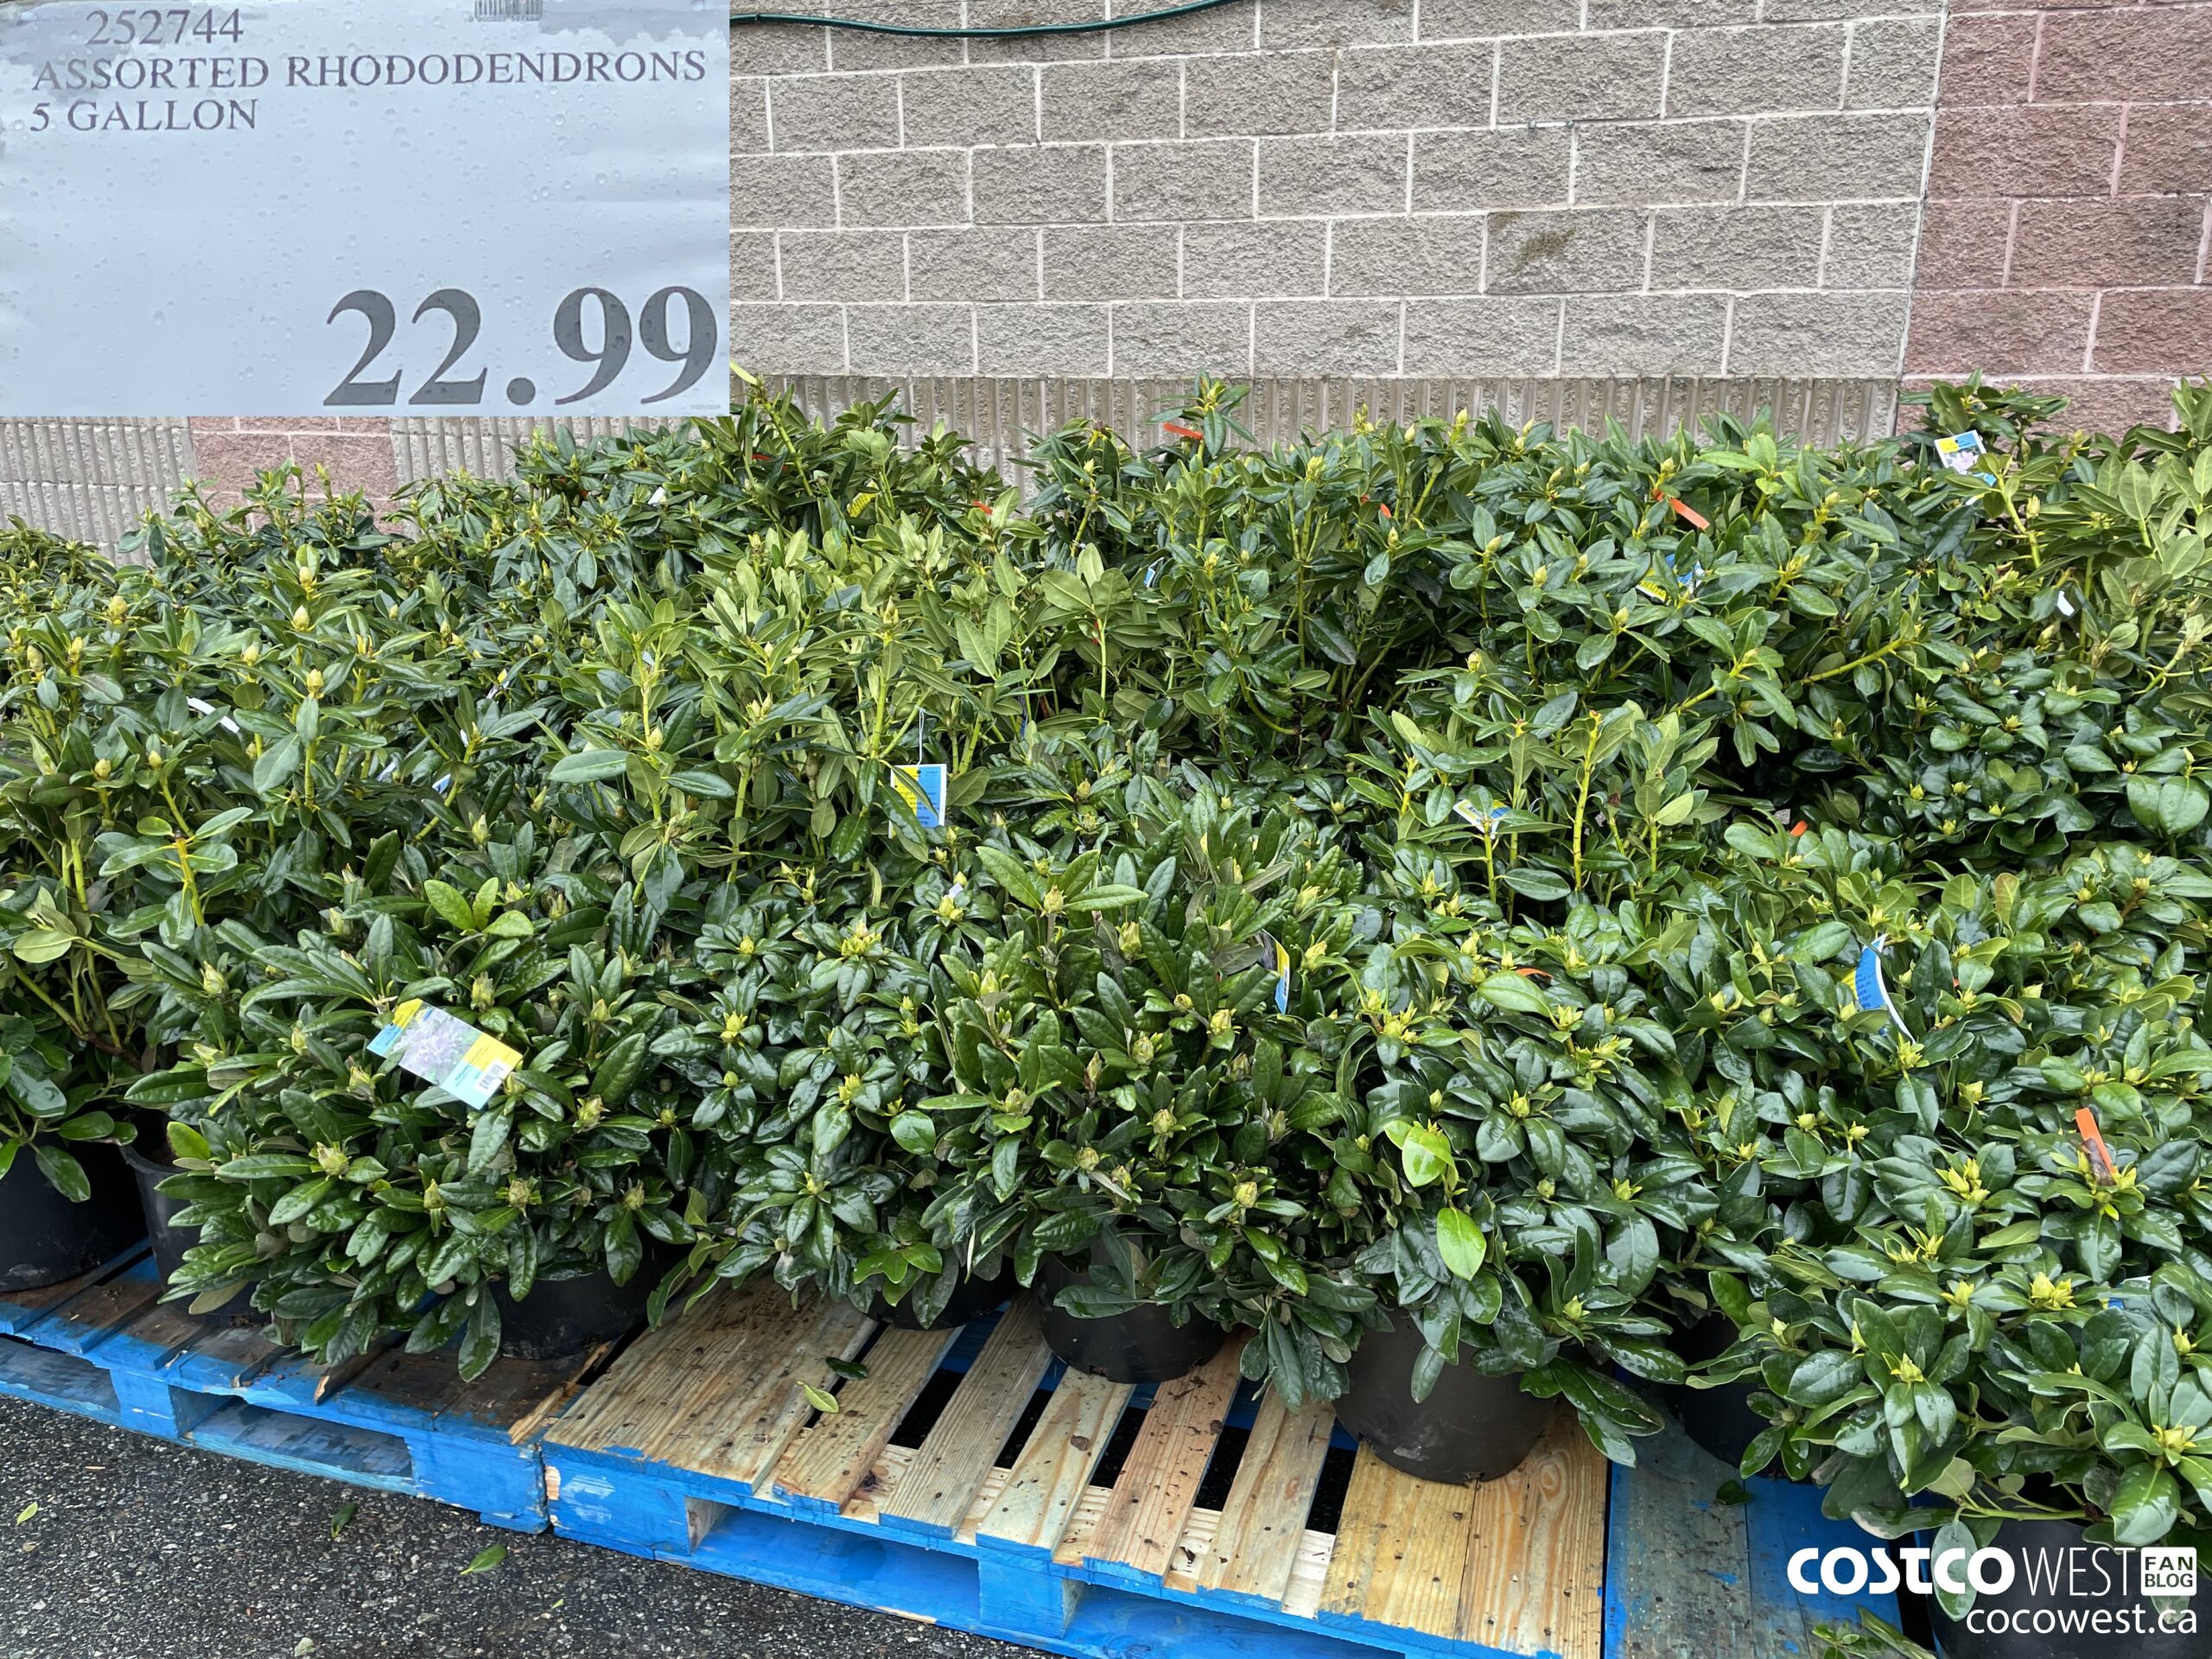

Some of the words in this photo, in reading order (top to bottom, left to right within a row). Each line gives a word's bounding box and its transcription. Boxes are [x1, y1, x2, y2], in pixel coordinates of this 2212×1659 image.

[87, 9, 243, 44] 252744
[33, 58, 268, 90] ASSORTED
[289, 52, 705, 87] RHODODENDRONS
[30, 102, 50, 131] 5
[68, 99, 257, 130] GALLON
[324, 287, 717, 405] 22.99
